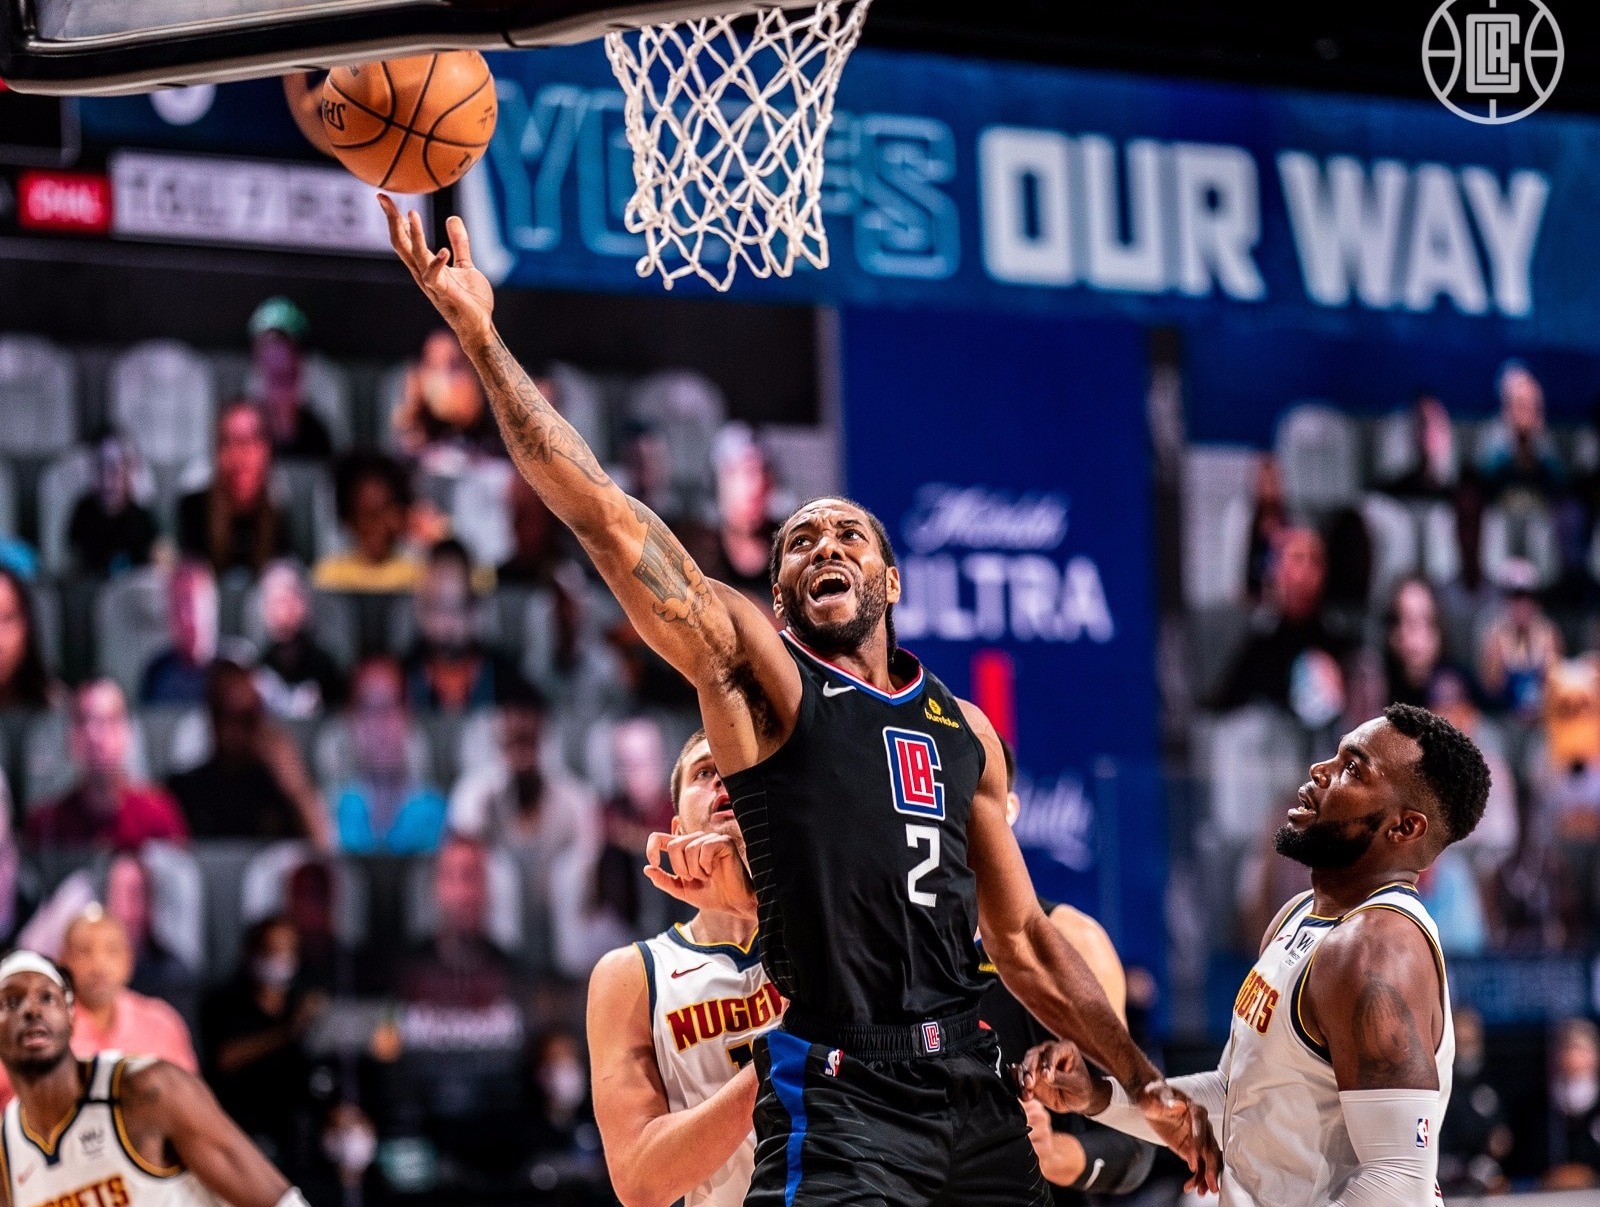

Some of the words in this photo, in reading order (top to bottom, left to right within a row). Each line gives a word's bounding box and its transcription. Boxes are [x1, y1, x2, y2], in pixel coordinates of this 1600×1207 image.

[978, 124, 1265, 301] OUR
[1276, 150, 1550, 319] WAY
[905, 823, 940, 908] 2
